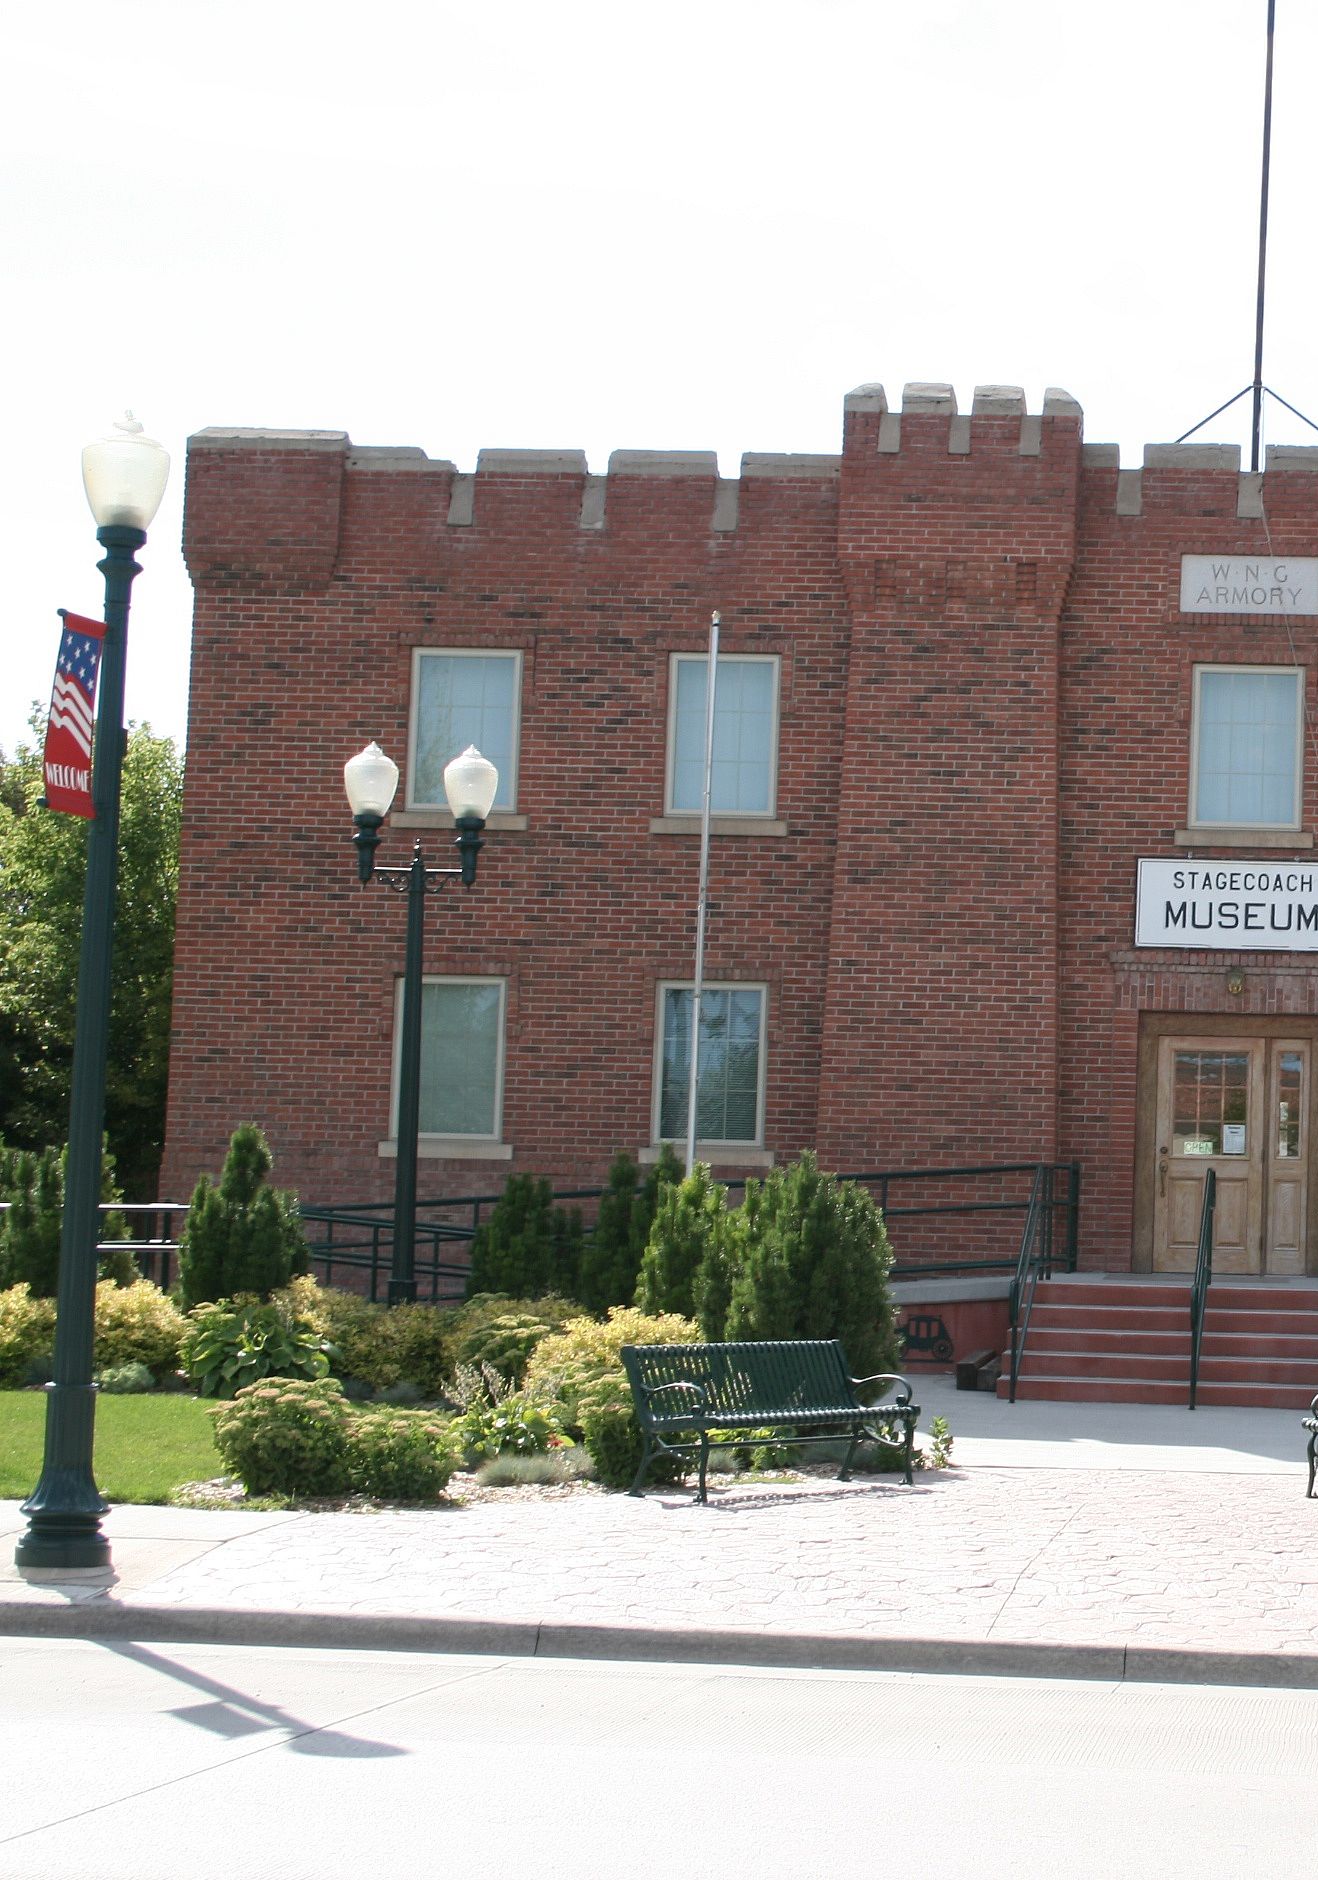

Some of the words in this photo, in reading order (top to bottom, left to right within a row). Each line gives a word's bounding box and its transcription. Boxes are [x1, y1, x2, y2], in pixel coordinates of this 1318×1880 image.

[1196, 586, 1303, 606] ARMORY
[45, 761, 91, 794] WELCOME
[1173, 871, 1314, 893] STAGECOACH
